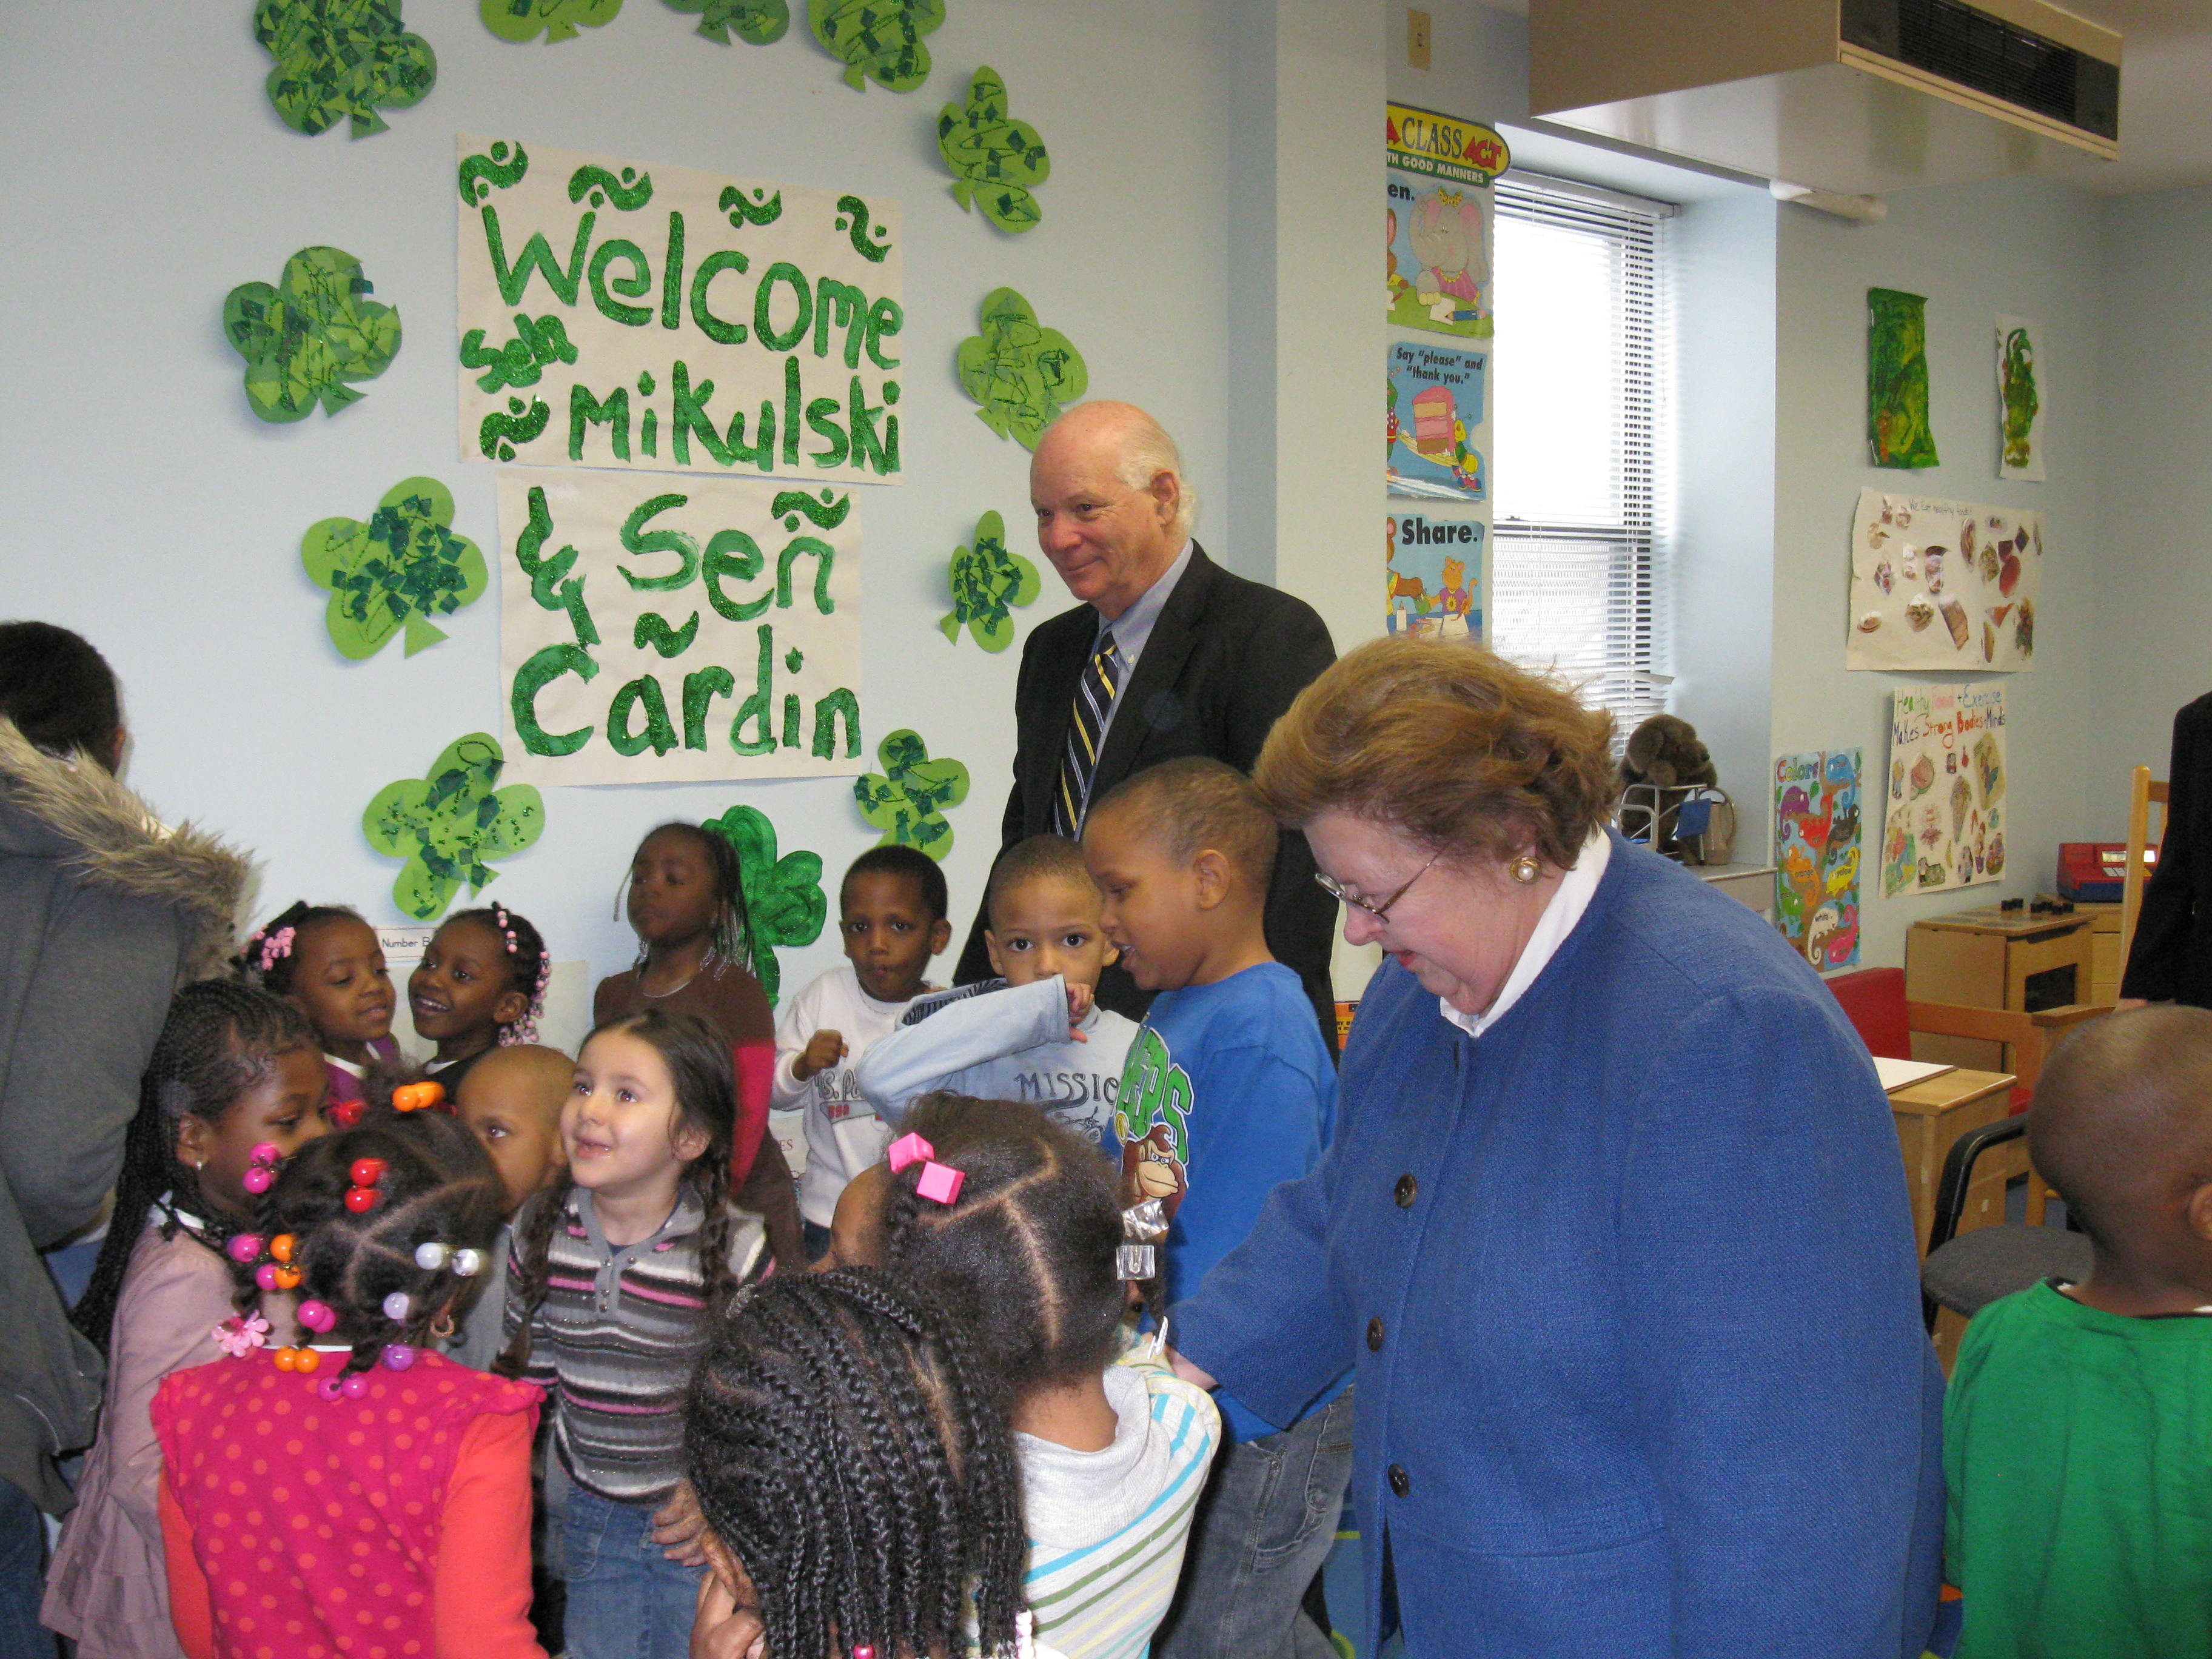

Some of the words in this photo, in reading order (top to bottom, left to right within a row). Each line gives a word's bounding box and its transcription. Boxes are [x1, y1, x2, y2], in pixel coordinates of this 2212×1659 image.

[1401, 117, 1463, 159] CLASS
[1463, 136, 1502, 170] ACT
[1401, 155, 1434, 172] GOOD
[1436, 163, 1484, 184] MANNERS
[1387, 184, 1415, 201] en.
[480, 204, 904, 370] Welcome
[458, 313, 579, 394] Sen
[1396, 347, 1415, 364] Say
[1464, 358, 1483, 370] and
[568, 355, 902, 476] Mikulski
[1402, 517, 1478, 545] Share.
[511, 624, 863, 760] Cardin
[1892, 718, 1920, 747] Makes
[1922, 714, 1954, 749] Strong
[1777, 757, 1818, 783] Colors
[1795, 869, 1813, 878] orange
[381, 937, 418, 948] Number
